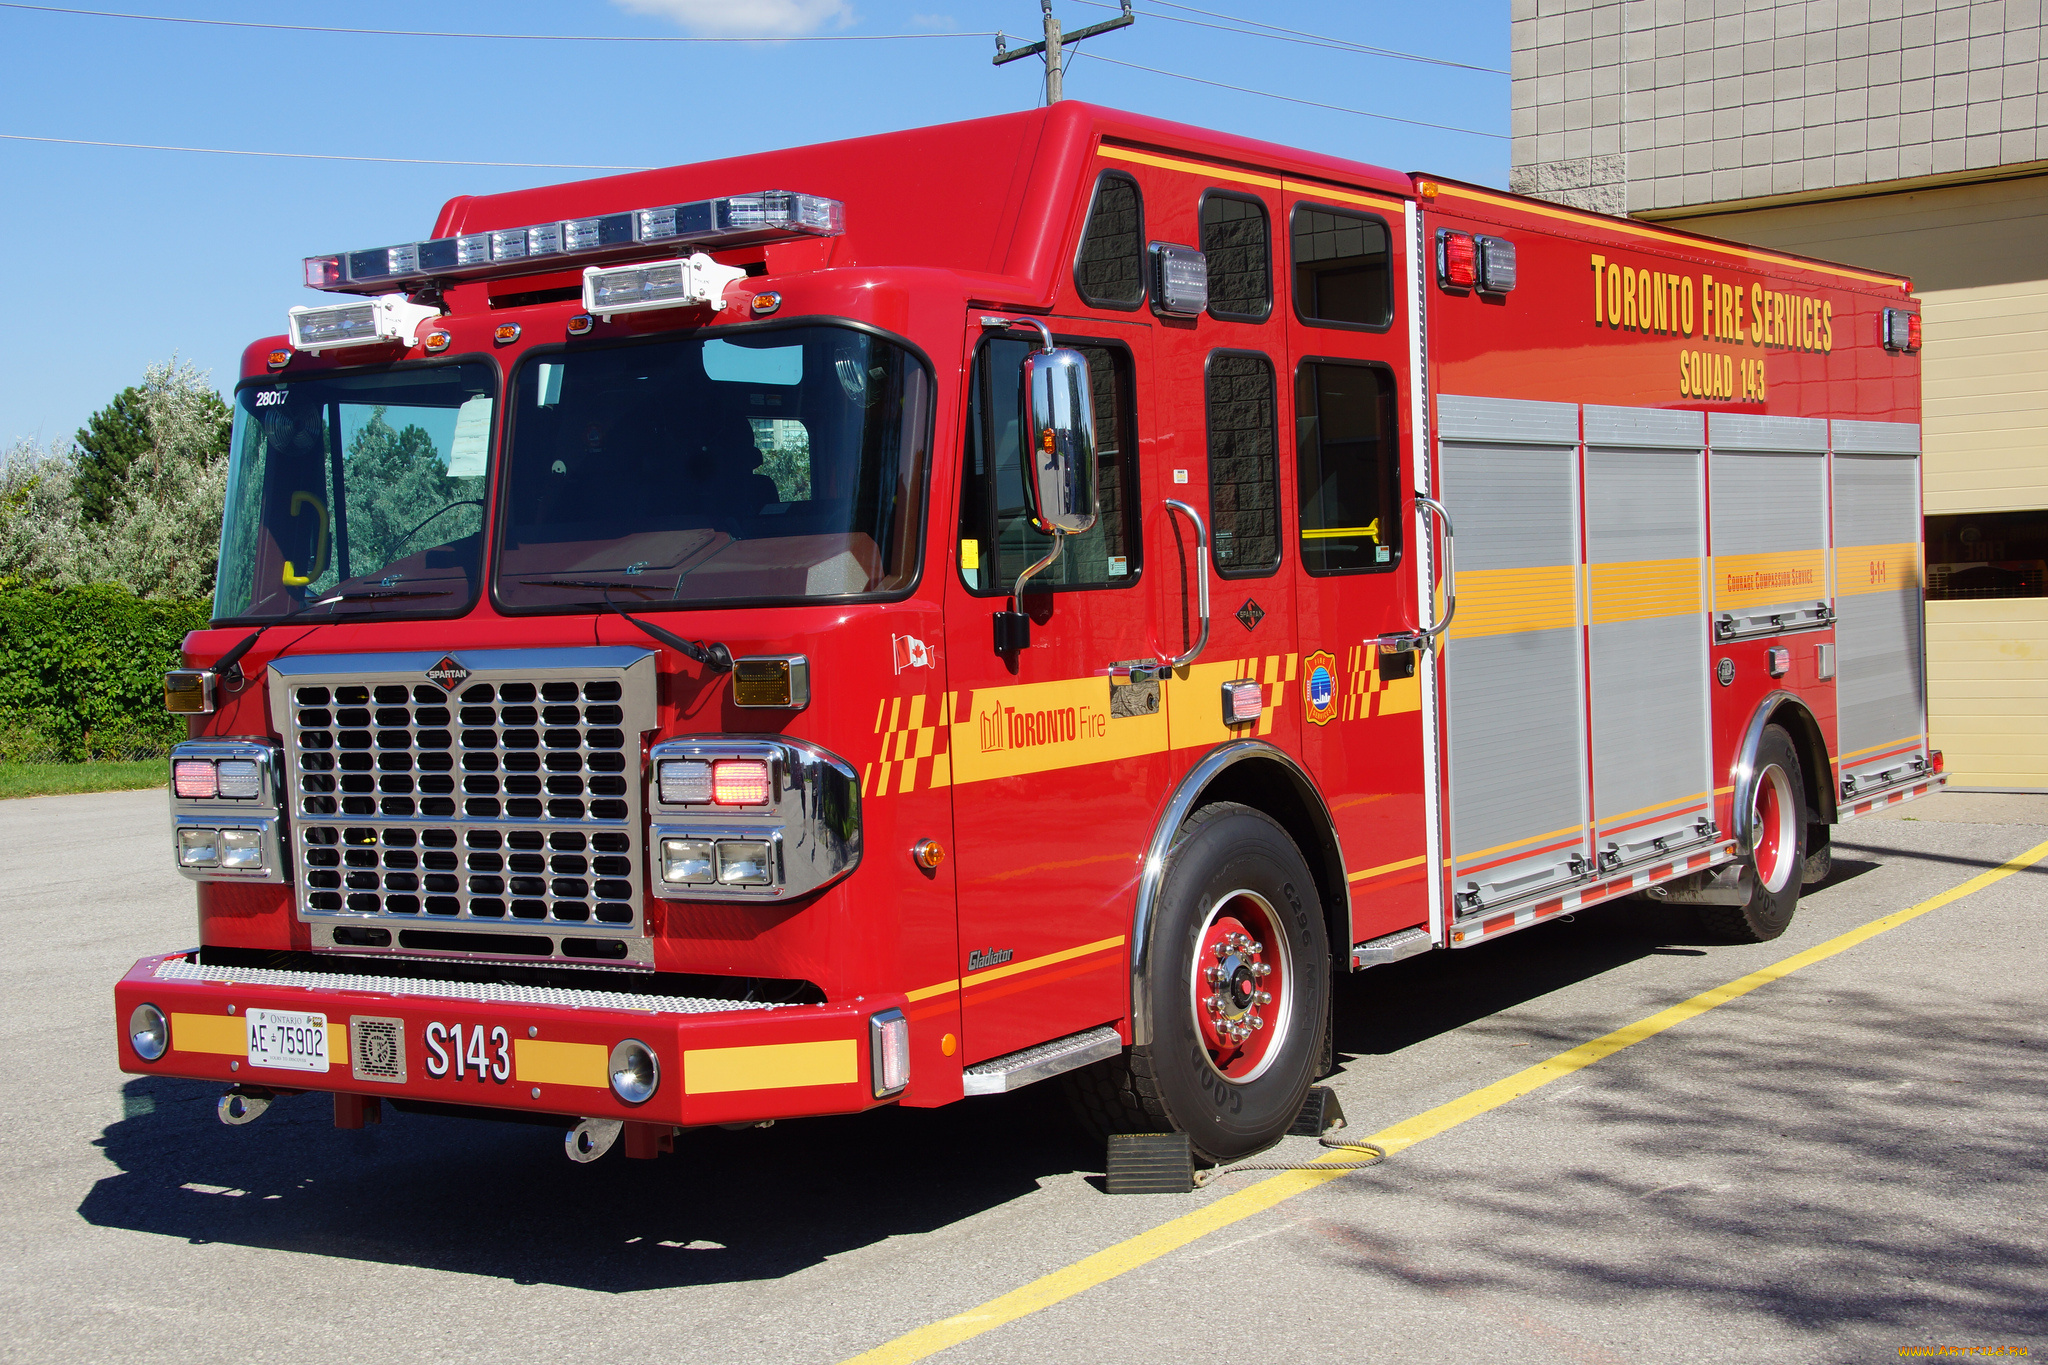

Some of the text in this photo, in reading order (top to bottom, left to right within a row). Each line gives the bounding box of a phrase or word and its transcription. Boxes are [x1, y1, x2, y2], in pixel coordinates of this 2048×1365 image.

[1591, 253, 1832, 356] TORONTO FIRE SERVICES
[1680, 349, 1765, 404] SQUAD 143
[256, 391, 289, 406] 28017
[1240, 610, 1263, 618] SPARTAN
[1314, 657, 1326, 665] FIRE
[429, 669, 467, 679] SPARTAN
[1312, 707, 1332, 719] SERVICES
[1005, 706, 1106, 749] TORONTO Fire
[968, 947, 1013, 971] Gladiator
[270, 1014, 303, 1025] ONTARIO
[277, 1025, 324, 1057] 75902
[425, 1021, 510, 1085] S143
